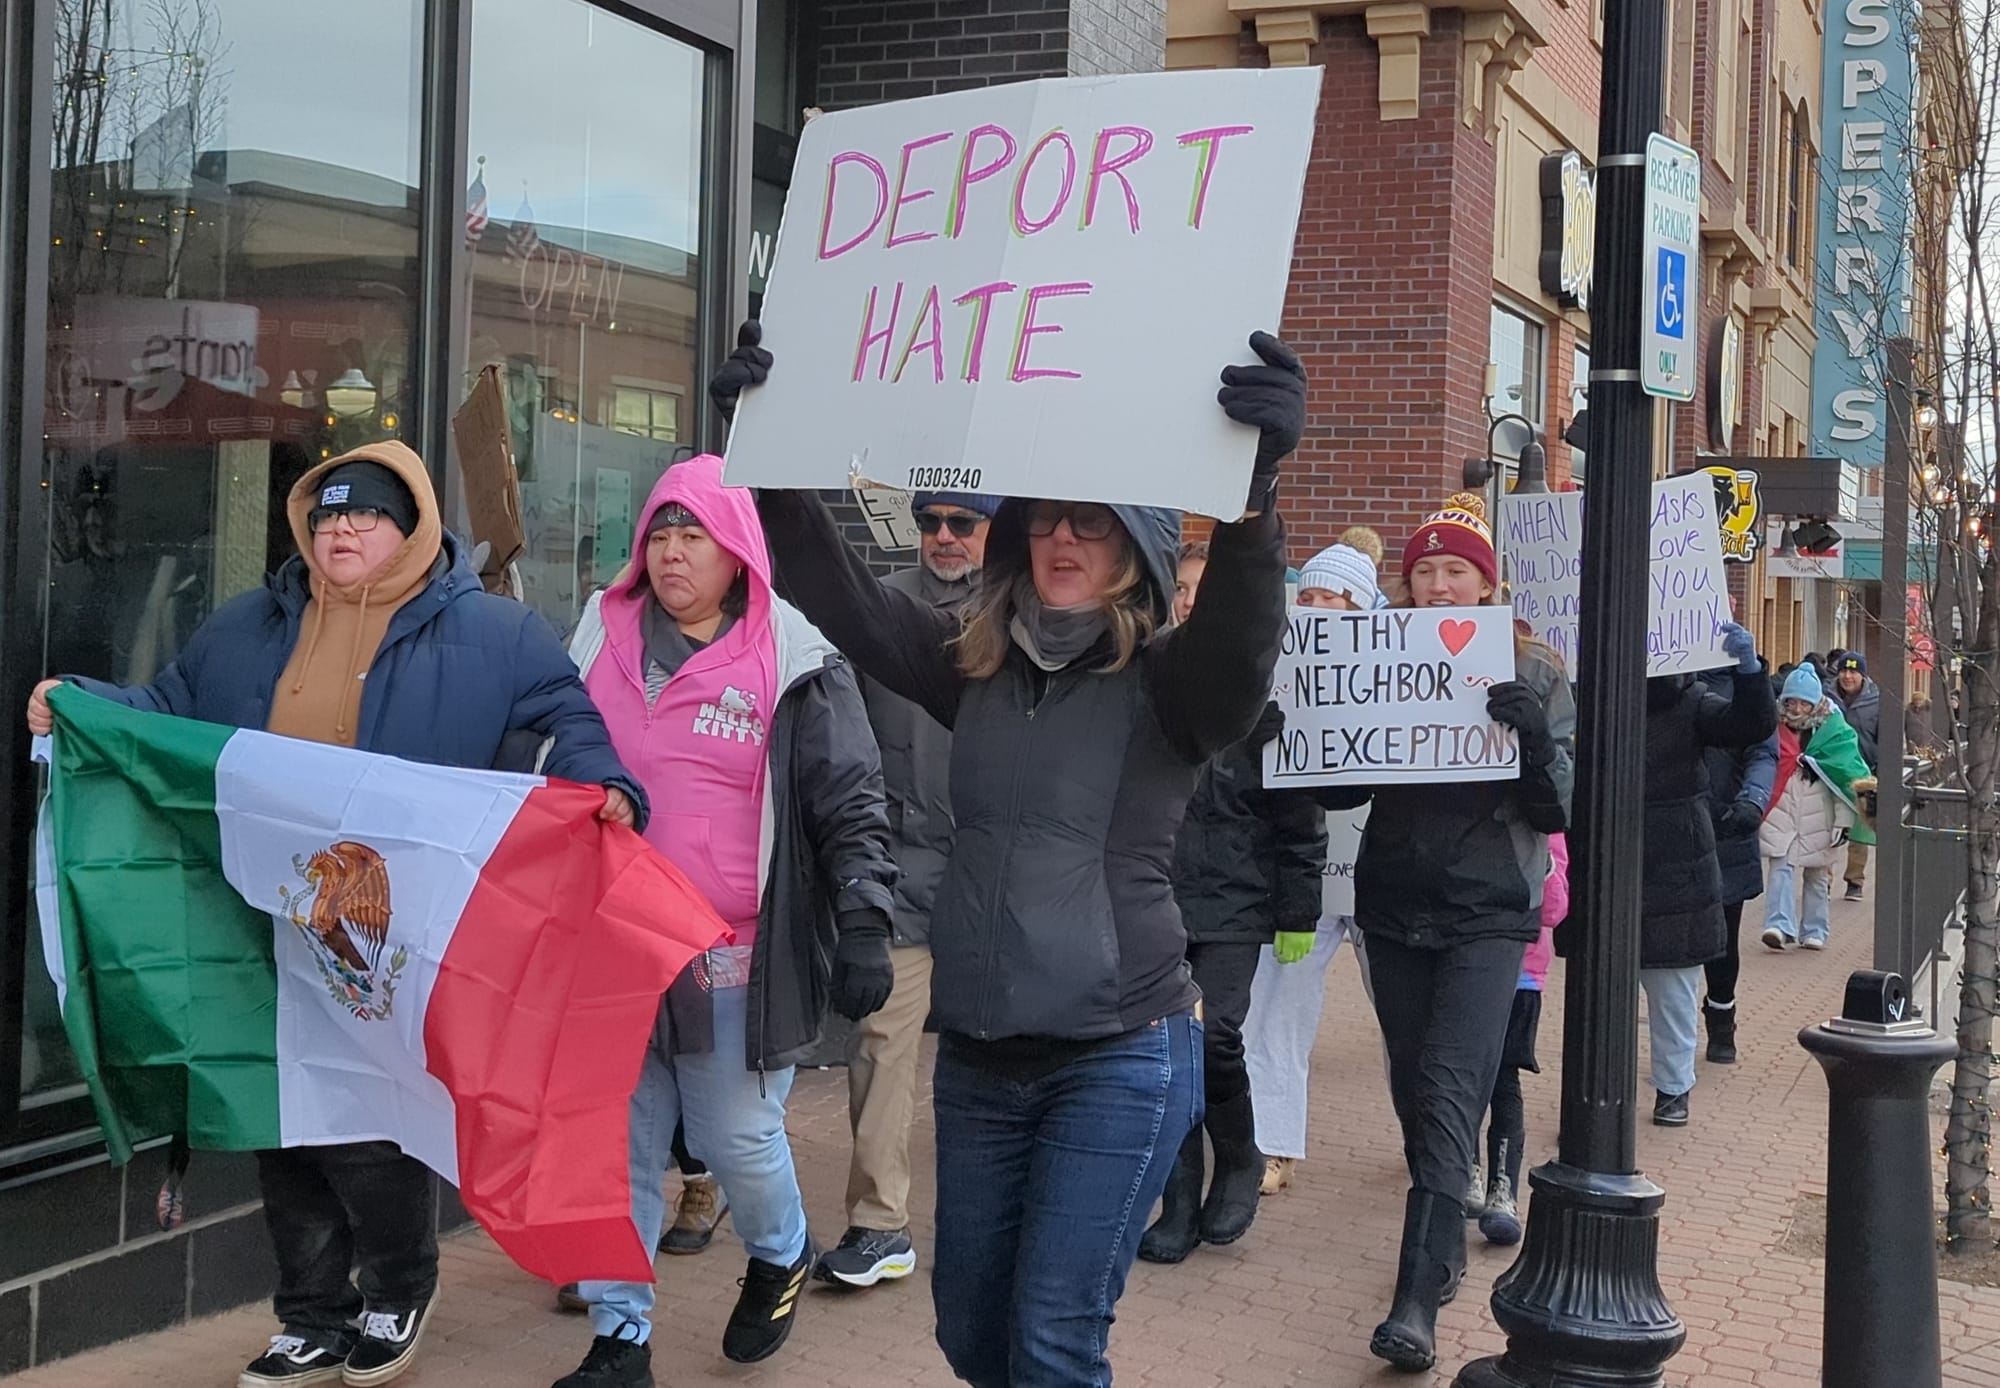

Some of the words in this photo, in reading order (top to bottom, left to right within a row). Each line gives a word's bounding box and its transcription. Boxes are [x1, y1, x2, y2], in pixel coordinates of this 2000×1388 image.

[815, 124, 1255, 262] DEPORT
[1650, 157, 1697, 203] RESERVED
[1652, 202, 1692, 245] PARKING
[1830, 0, 1890, 442] SPERRY'S
[521, 241, 625, 321] OPEN
[851, 281, 1094, 384] HATE
[1658, 350, 1678, 375] ONLY
[907, 466, 982, 489] 10303240
[1505, 497, 1569, 545] WHEN
[1649, 488, 1705, 528] Asks
[1281, 616, 1331, 656] OVE
[1340, 612, 1413, 654] THY
[1294, 660, 1455, 709] NEIGHBOR
[692, 717, 763, 747] KITTY
[699, 702, 765, 736] HELLO
[1275, 728, 1309, 773] NO
[1321, 723, 1518, 768] EXCEPTIONS
